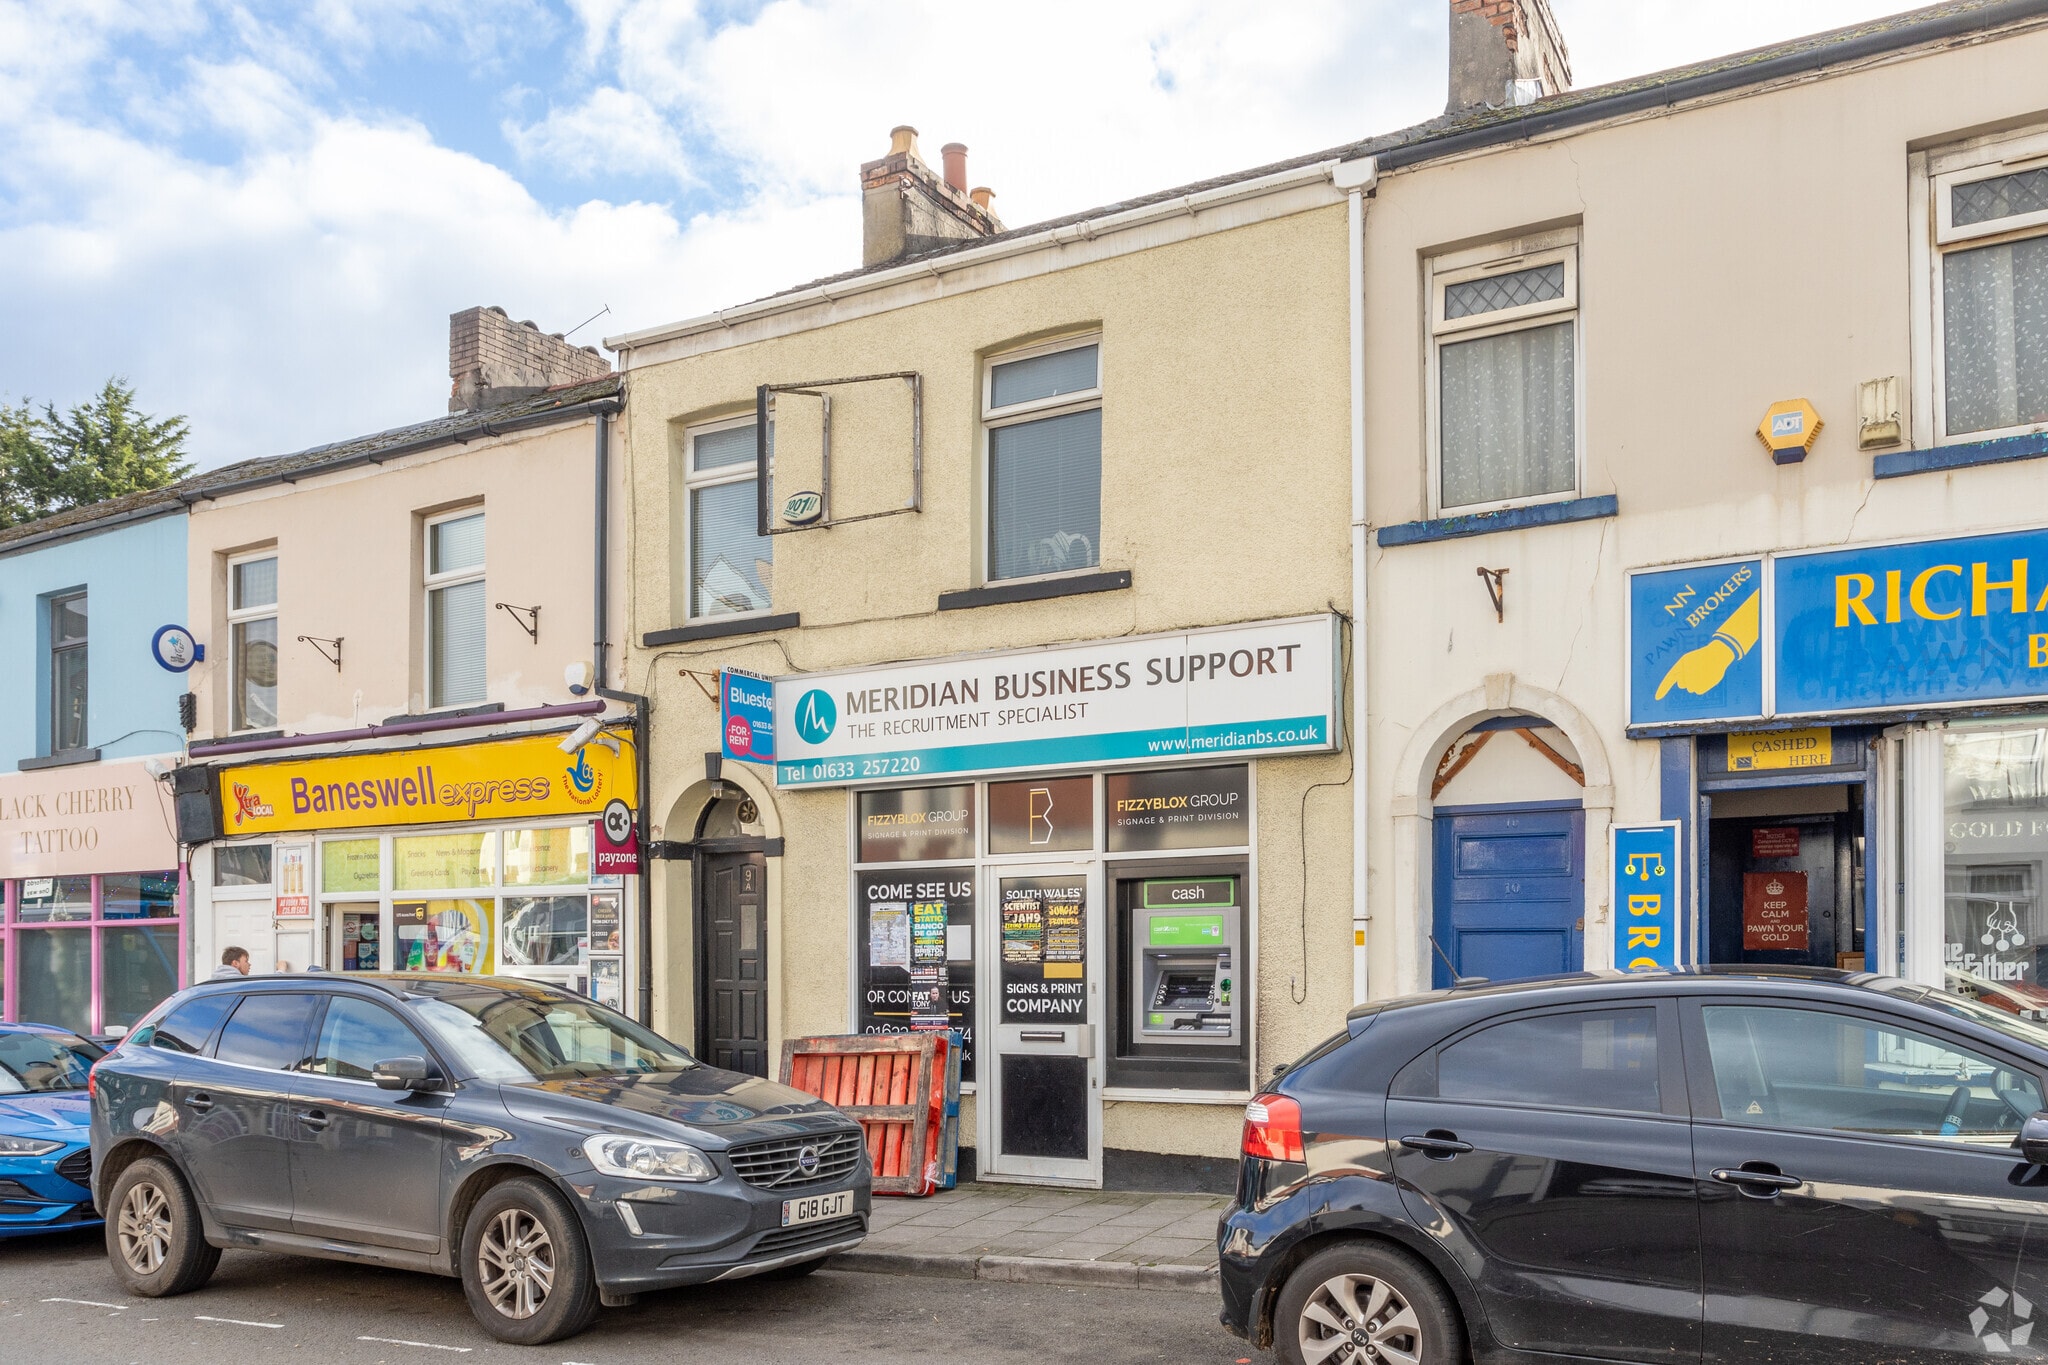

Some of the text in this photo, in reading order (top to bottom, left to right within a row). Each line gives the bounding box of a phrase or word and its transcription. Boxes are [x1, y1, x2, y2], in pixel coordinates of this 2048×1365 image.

[1773, 416, 1802, 432] ADT
[1664, 584, 1696, 617] NN
[1685, 565, 1752, 628] BROKERS
[727, 666, 760, 679] COMMERCIAL
[846, 643, 1301, 715] MERIDIAN BUSINESS SUPPORT
[752, 720, 767, 730] 01633
[847, 702, 1089, 739] THE RECRUITMENT SPECIALIST
[731, 725, 747, 735] FOR
[729, 736, 749, 746] RENT
[1752, 737, 1818, 753] CASHED
[784, 724, 1318, 782] Tel 01633 257220 www.meridianbs.co.uk
[1790, 754, 1828, 766] HERE
[291, 766, 550, 817] Baneswell express
[562, 772, 604, 805] The National Lottery
[56, 785, 138, 816] CHERRY
[233, 783, 261, 824] Xtra
[1117, 792, 1239, 812] FIZZYBLOX GROUP
[252, 804, 273, 816] LOCAL
[867, 809, 969, 826] FIZZYBLOX GROUP
[1117, 812, 1239, 826] SIGNAGE & PRINT DIVISION
[868, 831, 900, 839] SIGNAGE
[910, 829, 932, 837] PRINT
[934, 828, 969, 836] DIVISION
[1949, 821, 2048, 838] GOLD F
[21, 826, 98, 854] TATTOO
[347, 852, 378, 861] Frozen Foods
[408, 850, 426, 858] Snacks
[599, 852, 637, 866] payzone
[354, 871, 379, 880] Cigarettes
[411, 869, 433, 878] Greeting
[435, 868, 450, 876] Cards
[461, 867, 471, 875] Pay
[745, 870, 752, 882] 9
[867, 881, 971, 900] COME SEE US
[1006, 889, 1041, 899] SOUTH
[1172, 886, 1204, 900] cash
[914, 904, 943, 915] EAT
[1004, 902, 1040, 910] SCIENTIST
[1764, 901, 1787, 909] KEEP
[1012, 913, 1040, 923] JAH9
[1761, 910, 1789, 918] CALM
[1747, 924, 1804, 933] PAWN YOUR
[1761, 933, 1789, 942] GOLD
[1006, 983, 1083, 994] SIGNS & PRINT
[867, 990, 885, 1003] OR
[912, 992, 930, 1000] FAT
[952, 990, 970, 1003] US
[1006, 998, 1083, 1013] COMPANY
[798, 1194, 846, 1220] G18 GJT
